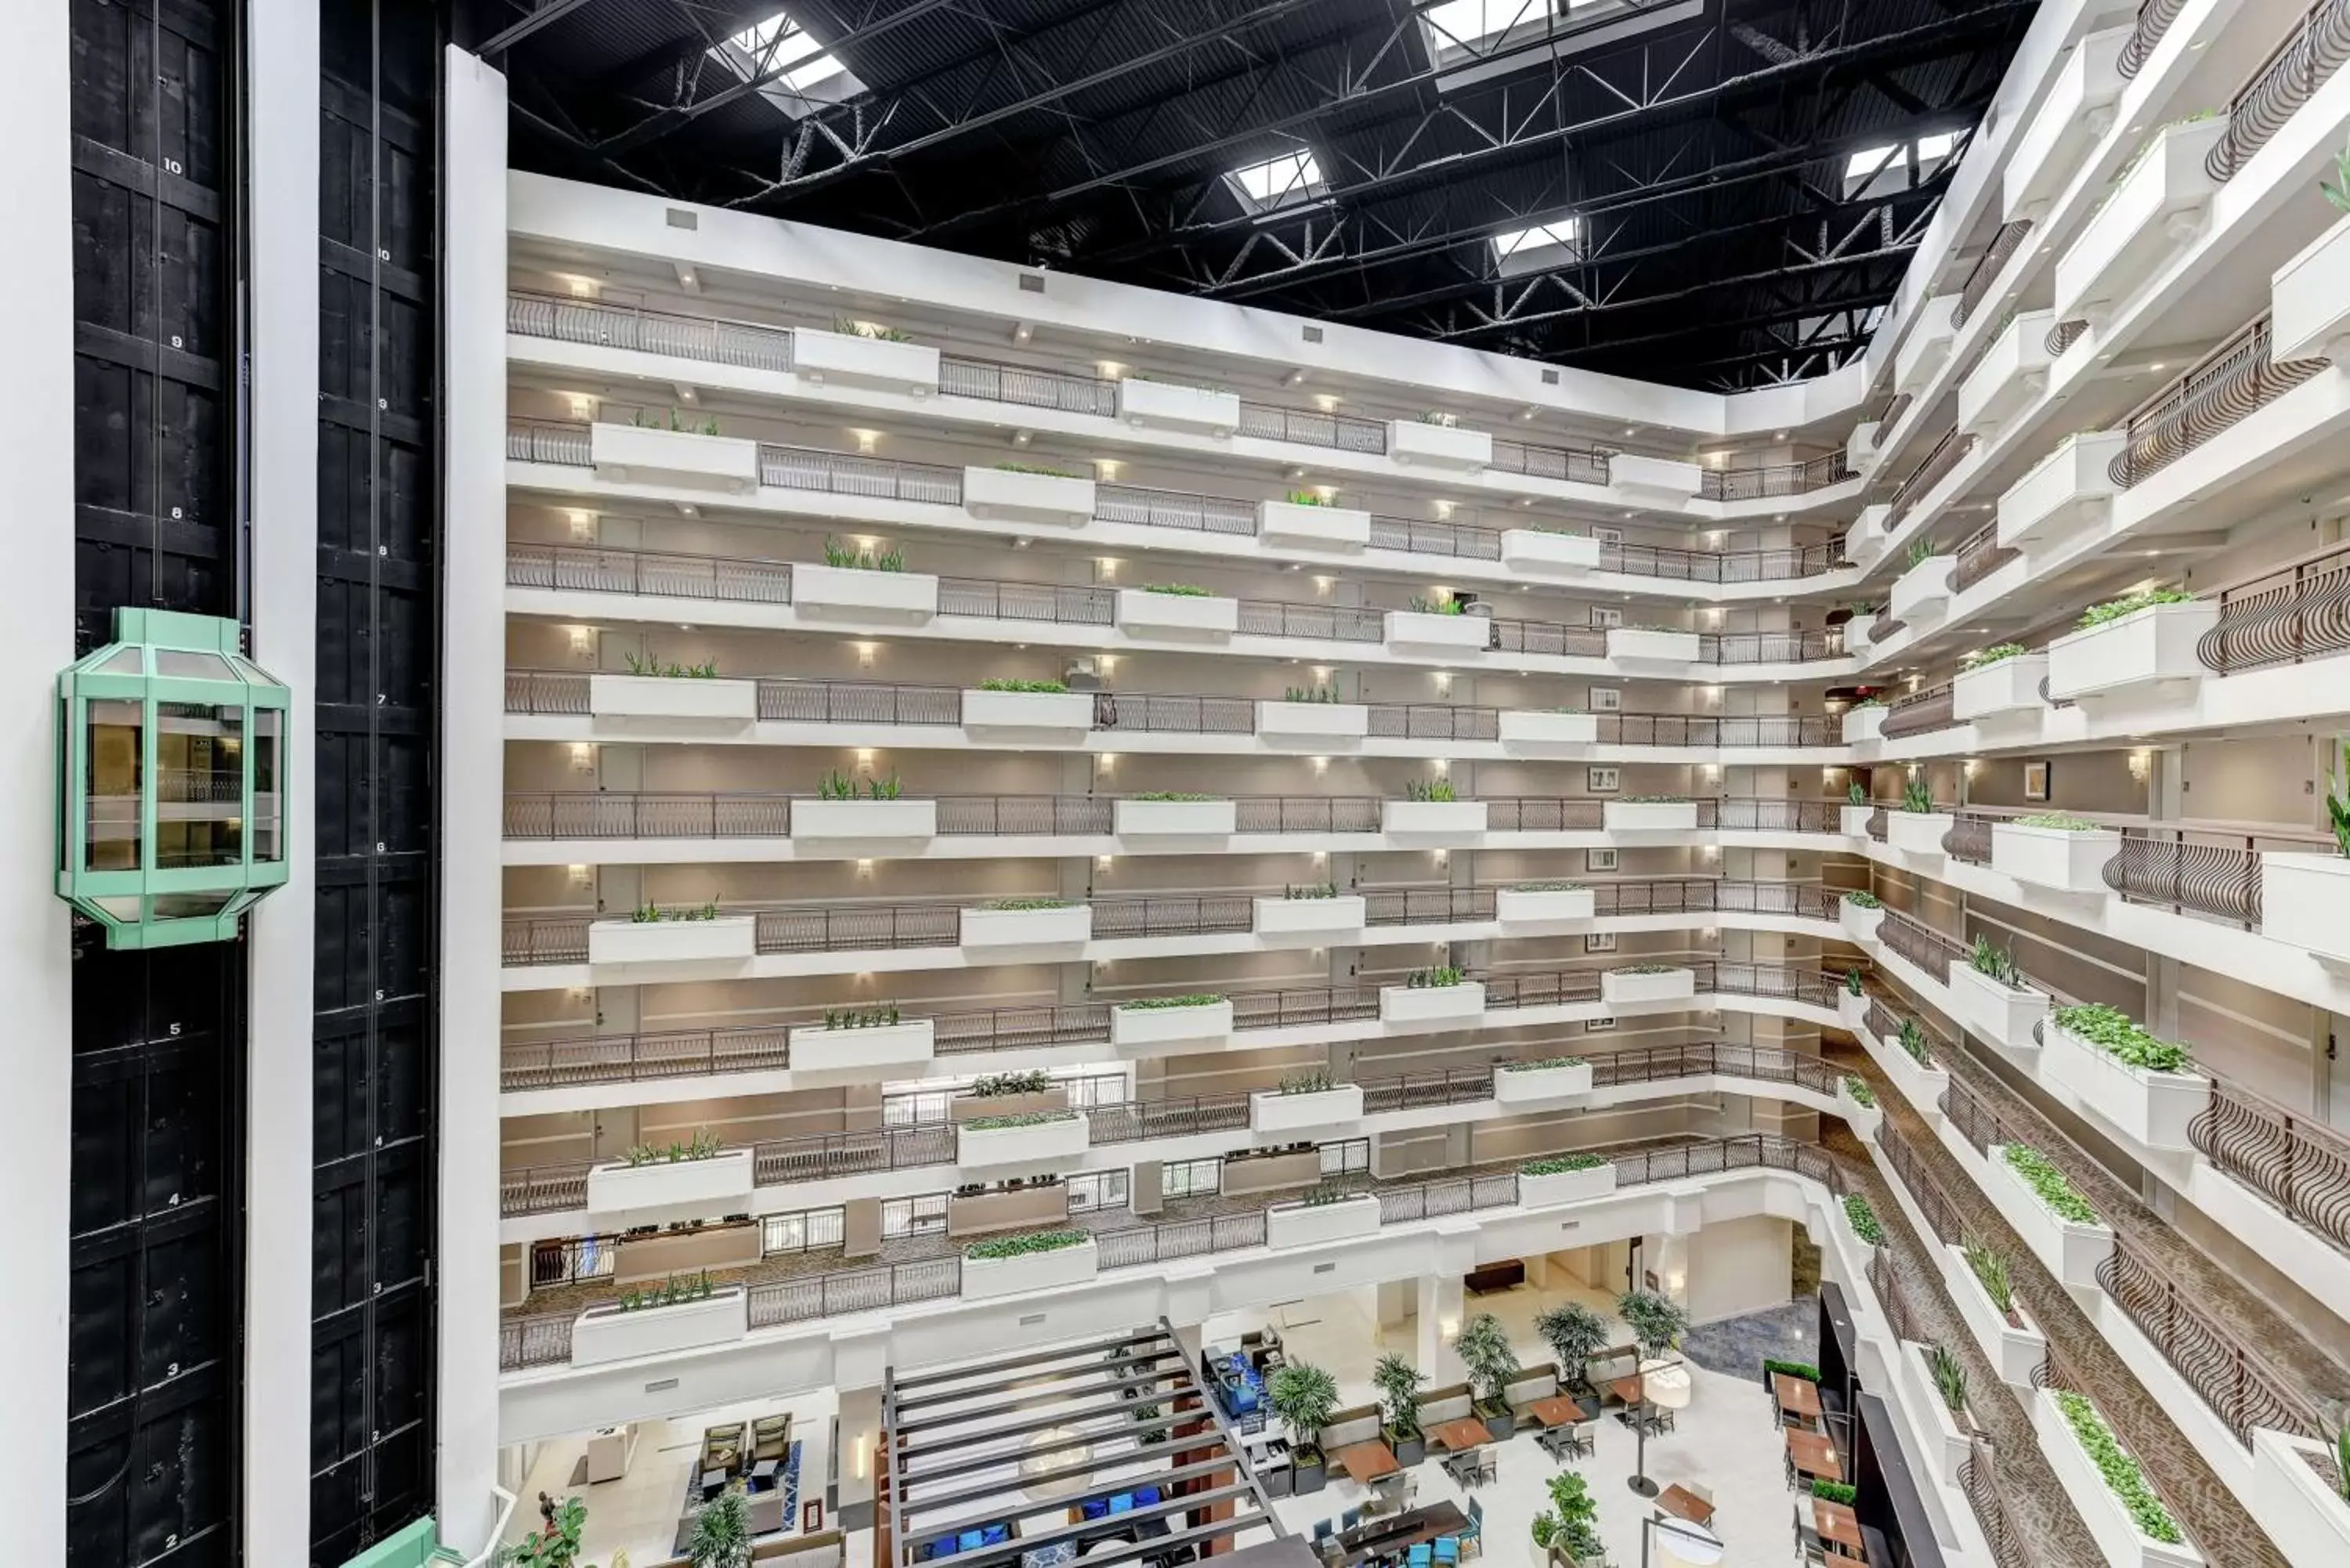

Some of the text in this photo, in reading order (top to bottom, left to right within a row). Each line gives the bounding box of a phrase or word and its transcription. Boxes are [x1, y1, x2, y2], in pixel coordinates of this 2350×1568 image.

[164, 157, 183, 175] 10
[171, 335, 183, 349] 9
[378, 398, 388, 410] 9
[172, 507, 183, 519] 8
[378, 545, 388, 556] 8
[378, 694, 386, 705] 7
[377, 842, 385, 851] 6
[375, 989, 384, 1001] 5
[170, 1023, 181, 1035] 5
[374, 1136, 383, 1147] 4
[168, 1193, 179, 1205] 4
[374, 1283, 381, 1294] 3
[168, 1363, 179, 1375] 3
[372, 1431, 380, 1442] 2
[165, 1534, 177, 1548] 2
